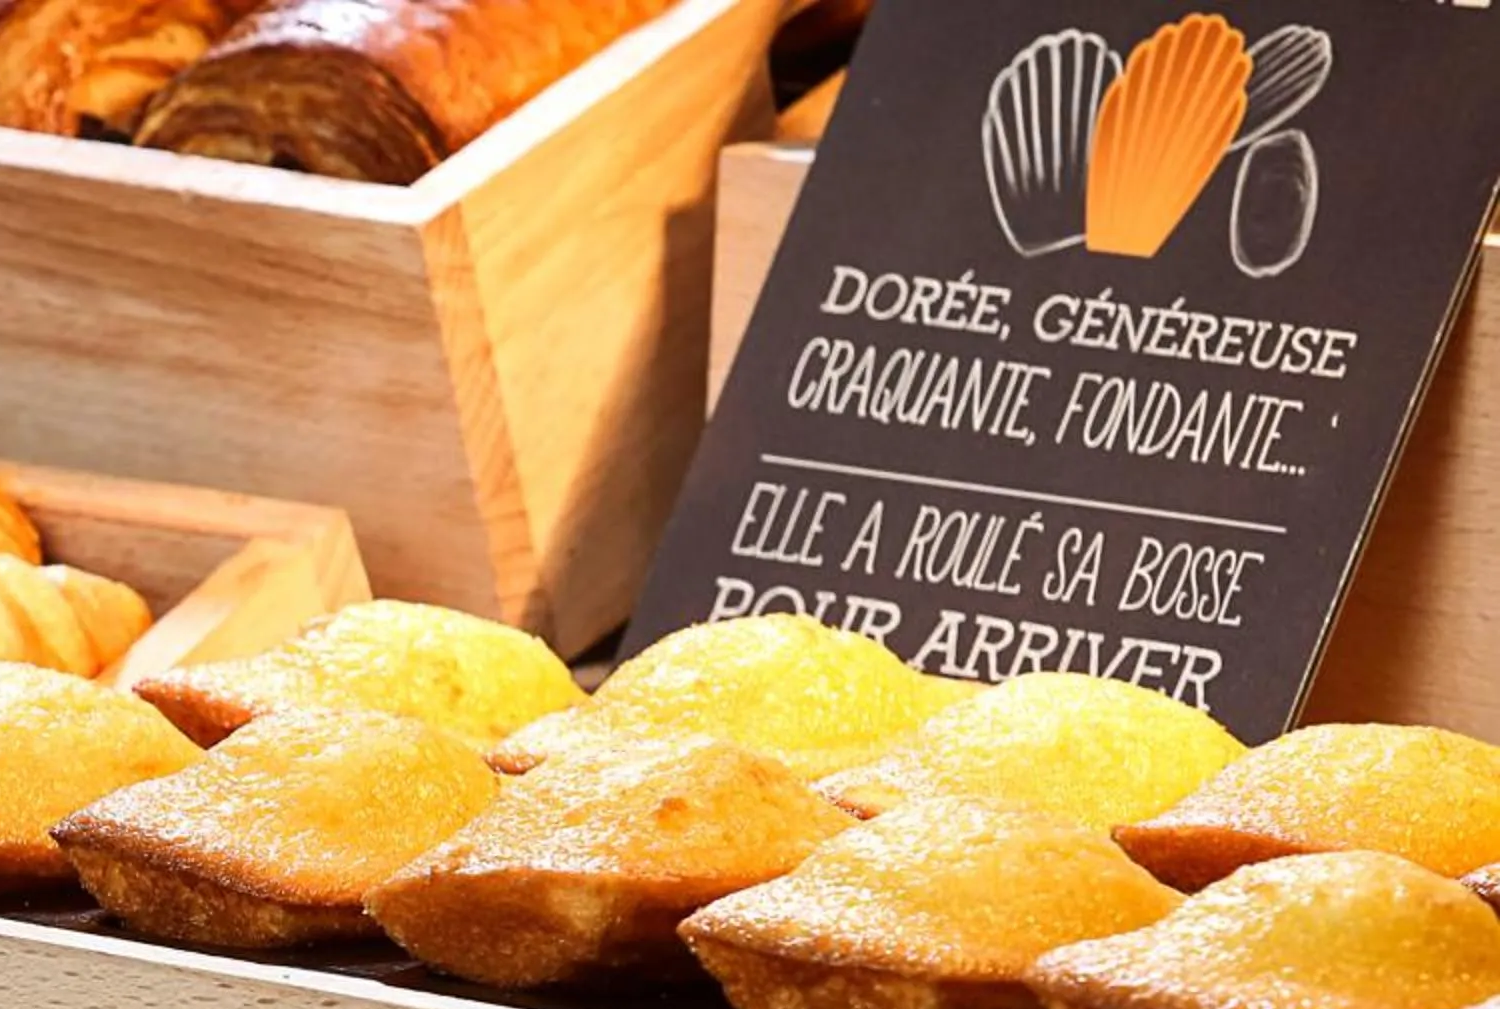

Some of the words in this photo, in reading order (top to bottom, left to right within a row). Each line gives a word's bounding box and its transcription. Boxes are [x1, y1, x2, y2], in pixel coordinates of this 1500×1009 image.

[820, 264, 1012, 341] DORÉE,
[1032, 287, 1357, 378] GÉNÉREUSE
[786, 336, 1052, 446] CRAQUANTE,
[731, 481, 847, 566] ELLE
[841, 499, 884, 575] A
[895, 504, 1044, 595] ROULÉ
[1042, 526, 1104, 608] SA
[1118, 535, 1265, 627] BOSSE
[906, 609, 1224, 712] ARRIVER
